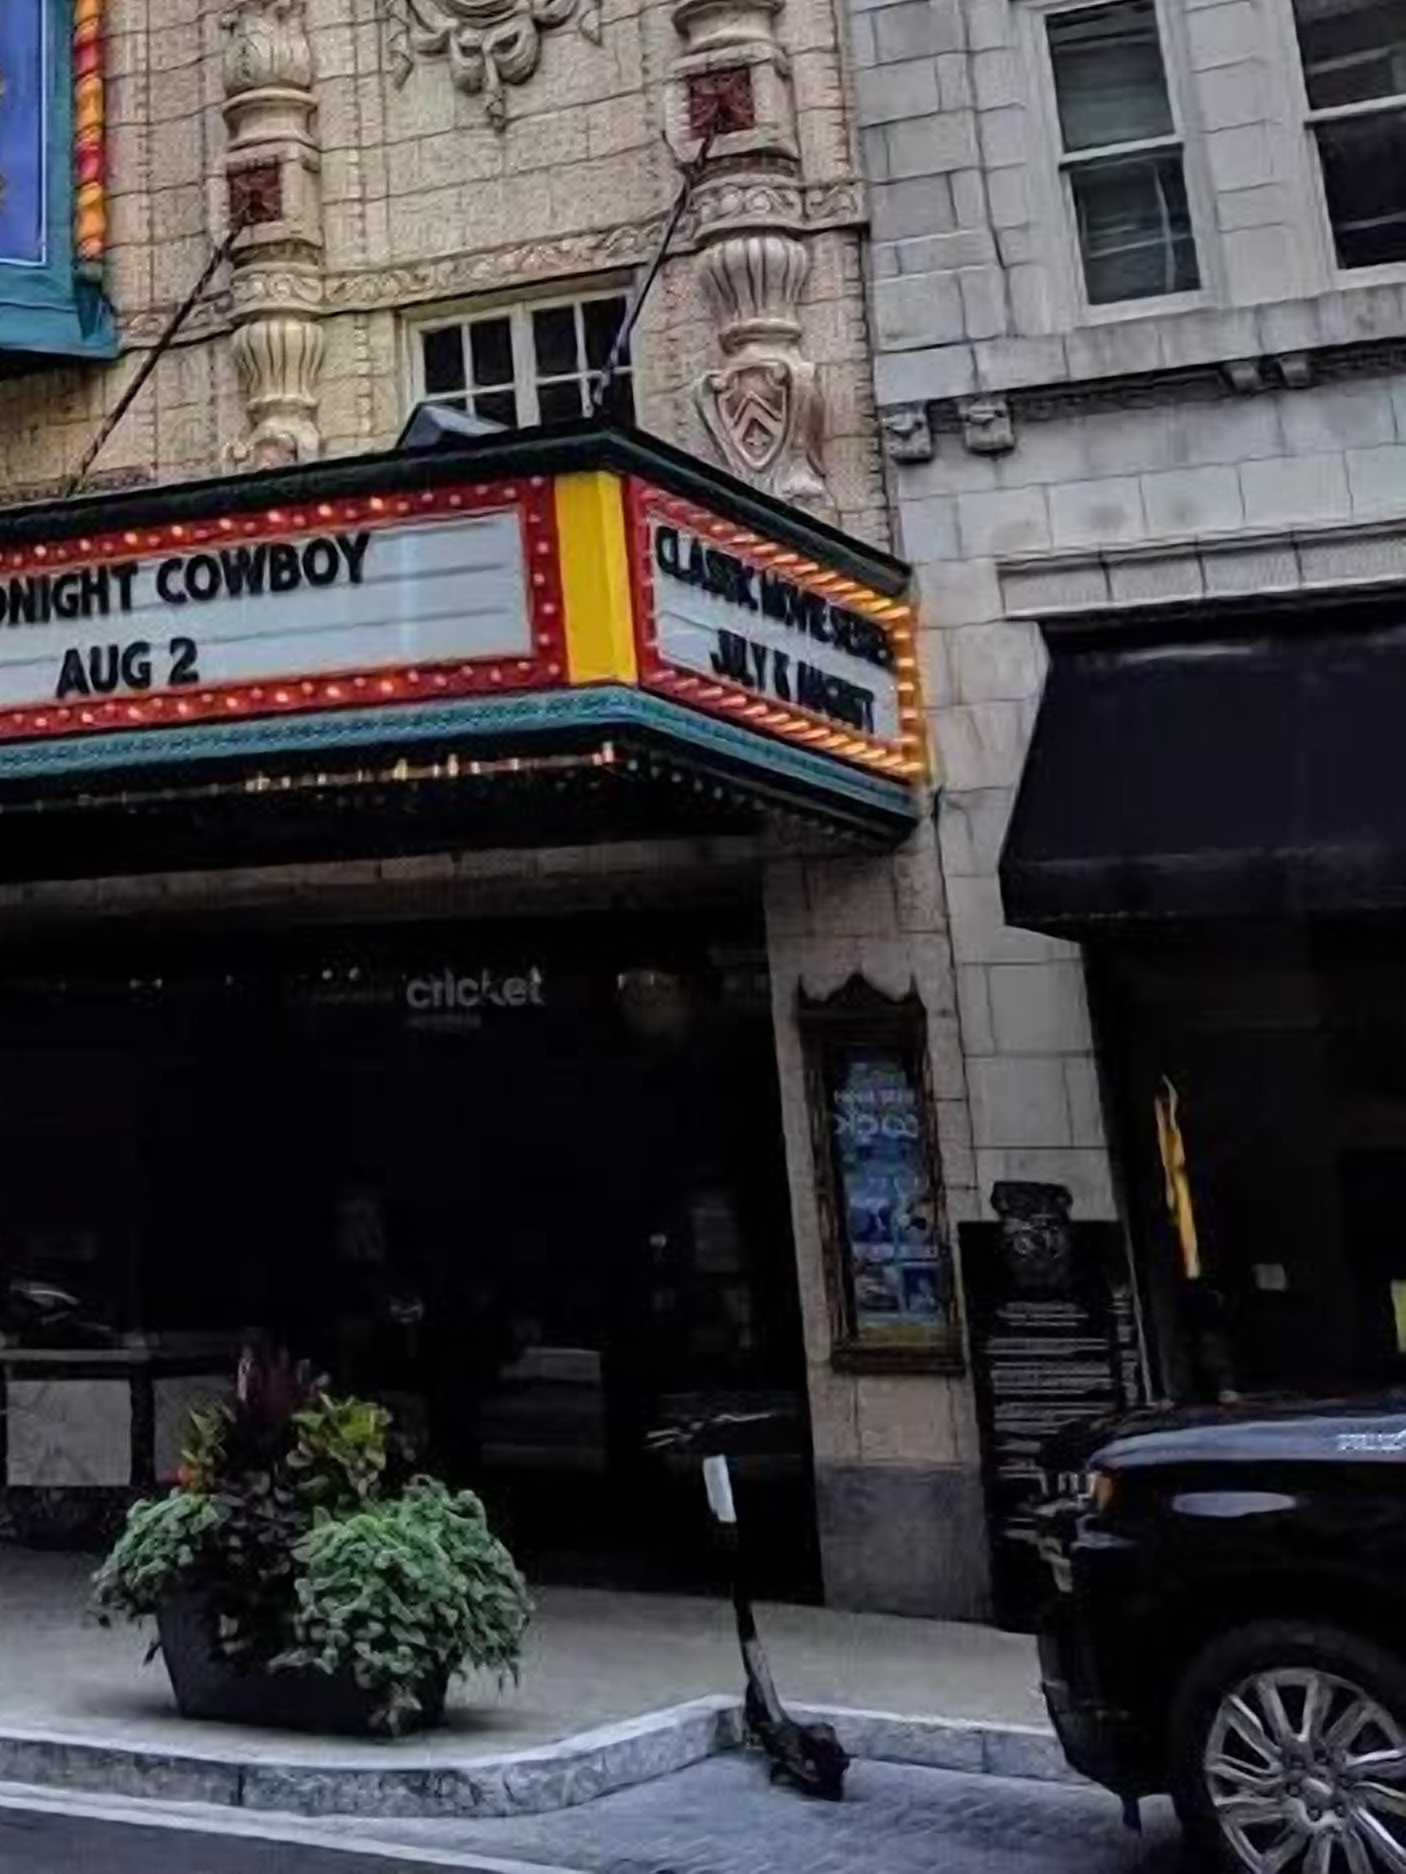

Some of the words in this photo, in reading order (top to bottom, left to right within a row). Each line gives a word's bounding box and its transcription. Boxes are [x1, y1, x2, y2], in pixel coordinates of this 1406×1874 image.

[156, 530, 371, 604] COWBOY
[56, 640, 153, 699] AUG
[167, 636, 200, 686] 2
[710, 628, 768, 693] JULY
[405, 966, 544, 1009] cricket
